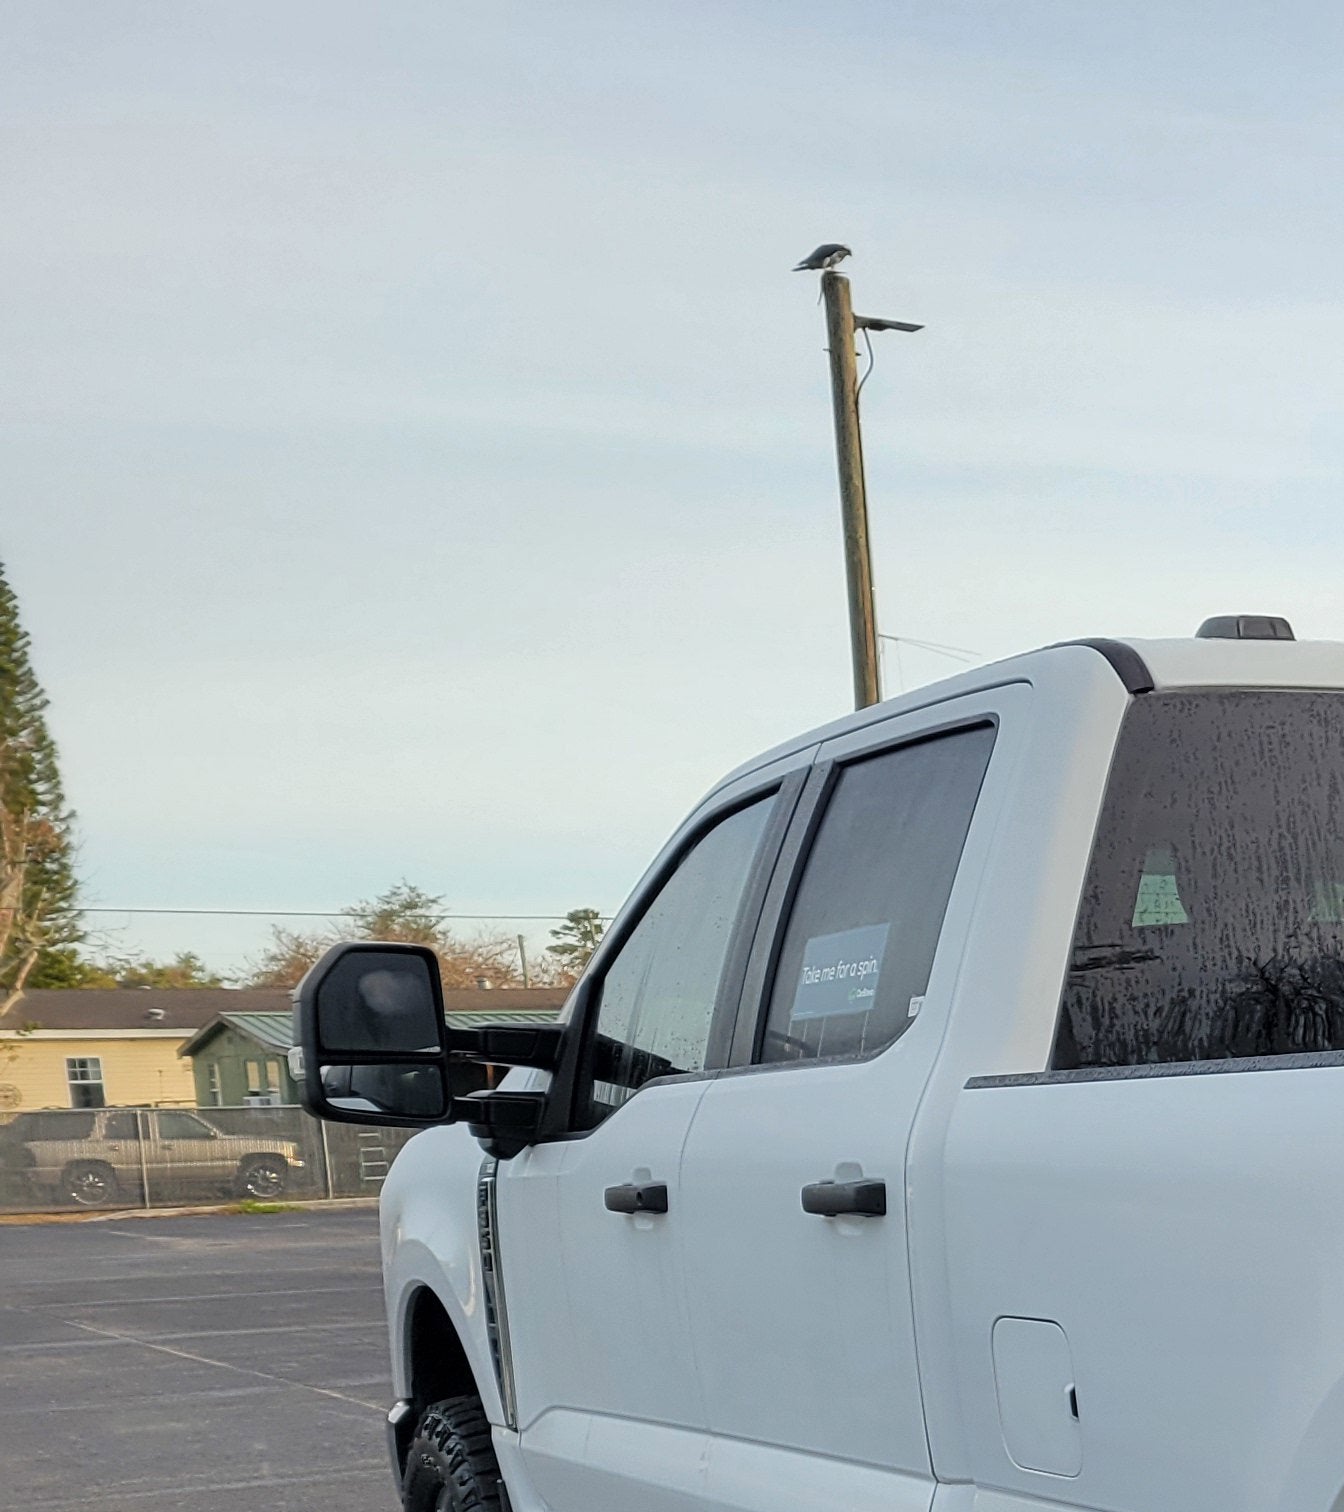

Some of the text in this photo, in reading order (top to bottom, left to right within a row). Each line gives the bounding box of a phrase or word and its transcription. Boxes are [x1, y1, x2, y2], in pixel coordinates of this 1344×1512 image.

[802, 966, 821, 984] Take
[821, 966, 836, 982] me
[836, 960, 851, 979] for
[849, 962, 857, 977] a
